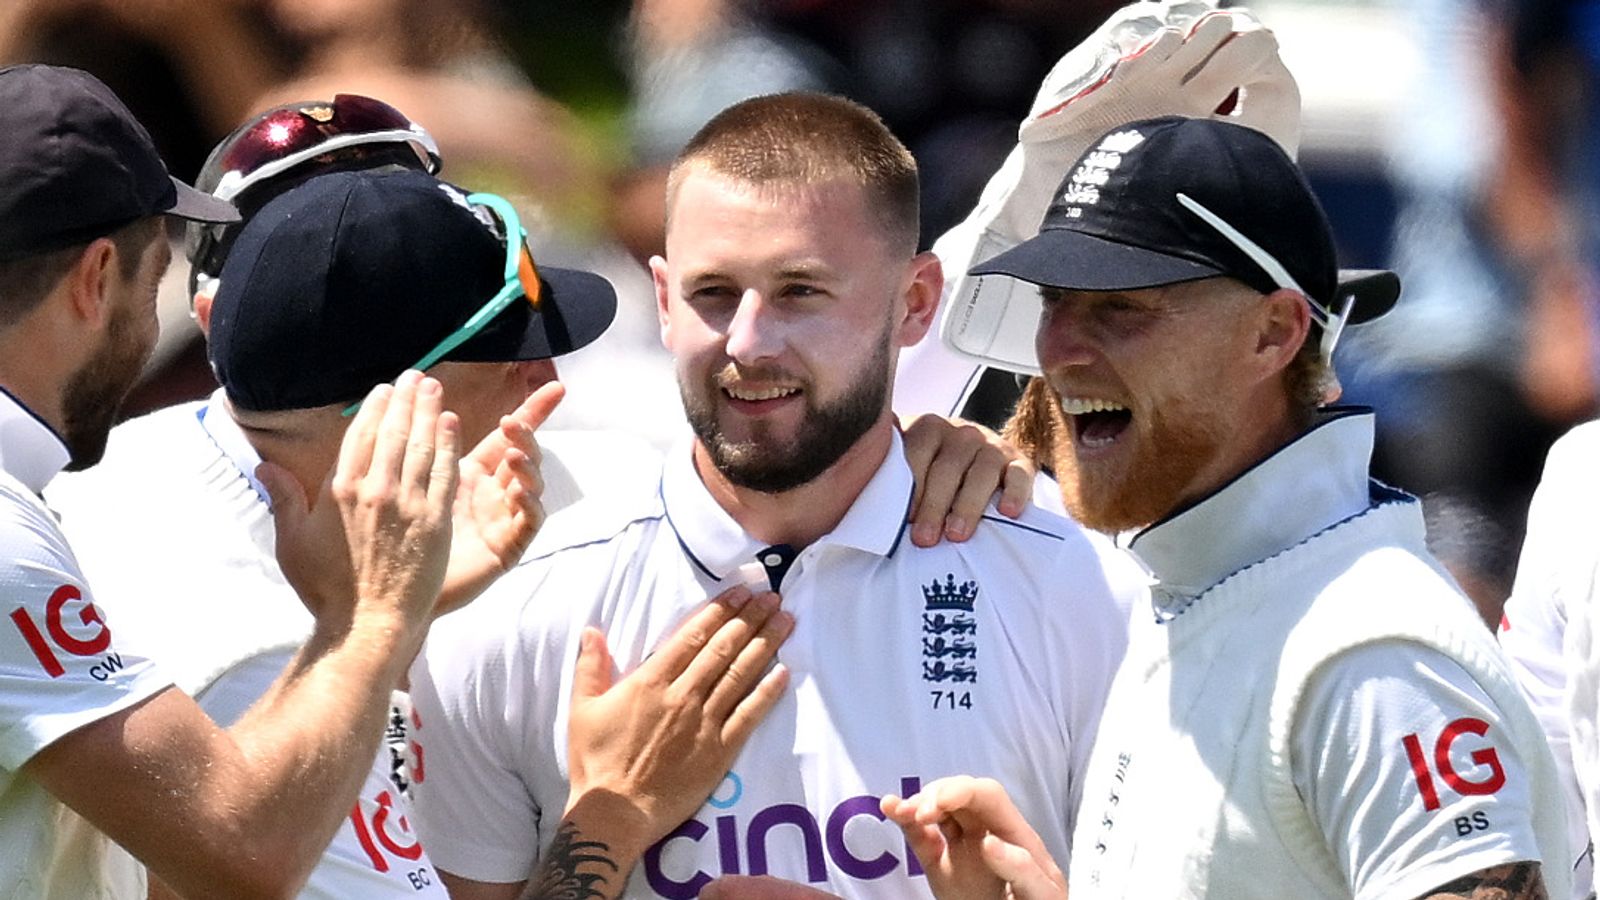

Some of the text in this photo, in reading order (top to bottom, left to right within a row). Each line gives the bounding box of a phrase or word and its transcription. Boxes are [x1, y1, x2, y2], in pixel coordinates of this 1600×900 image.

[11, 584, 111, 677] IG
[89, 651, 125, 682] CW
[930, 690, 973, 710] 714
[1402, 717, 1506, 811] IG
[1454, 810, 1490, 837] BS
[407, 867, 431, 891] BC
